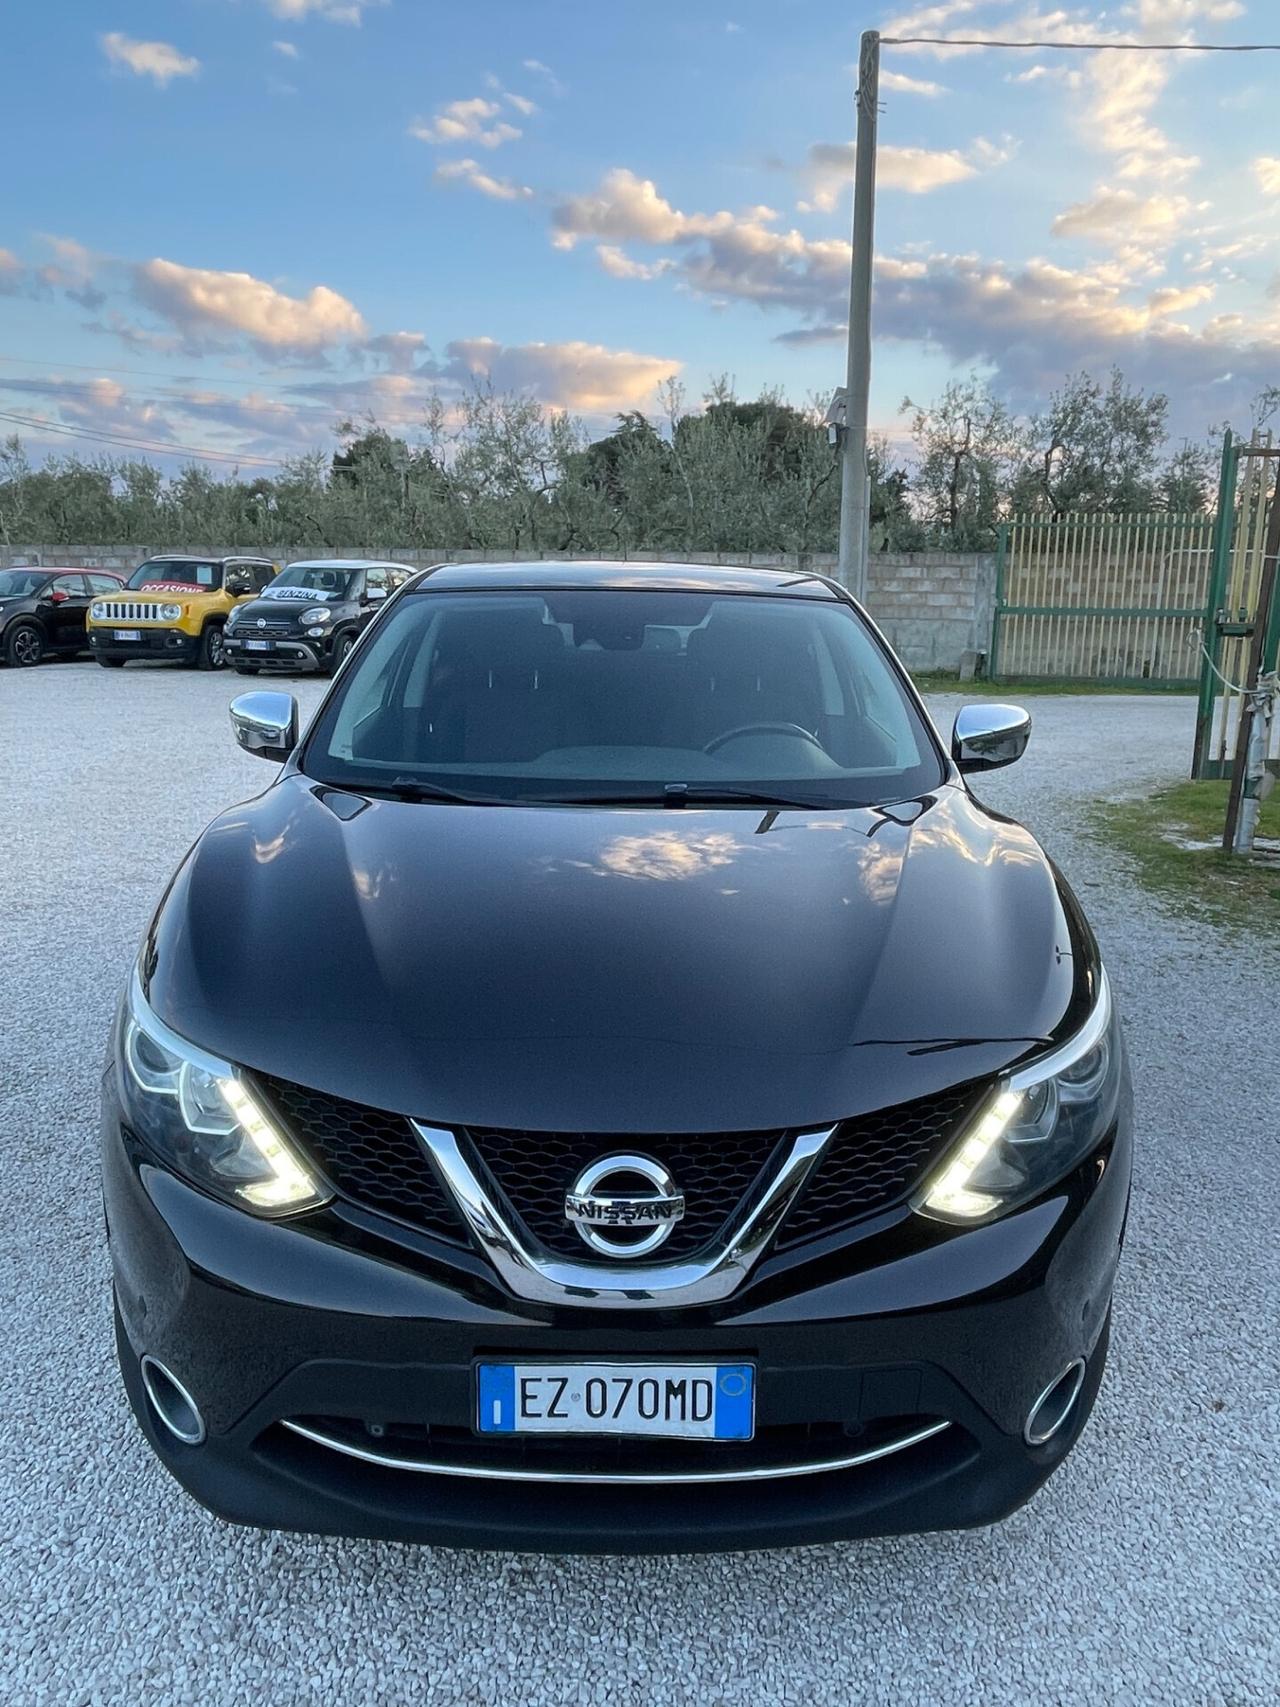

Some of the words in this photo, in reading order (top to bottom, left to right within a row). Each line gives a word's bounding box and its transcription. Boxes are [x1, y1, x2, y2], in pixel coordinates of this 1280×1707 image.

[577, 1200, 673, 1220] NISSAN
[520, 1377, 568, 1418] EZ
[585, 1378, 713, 1422] 070MD
